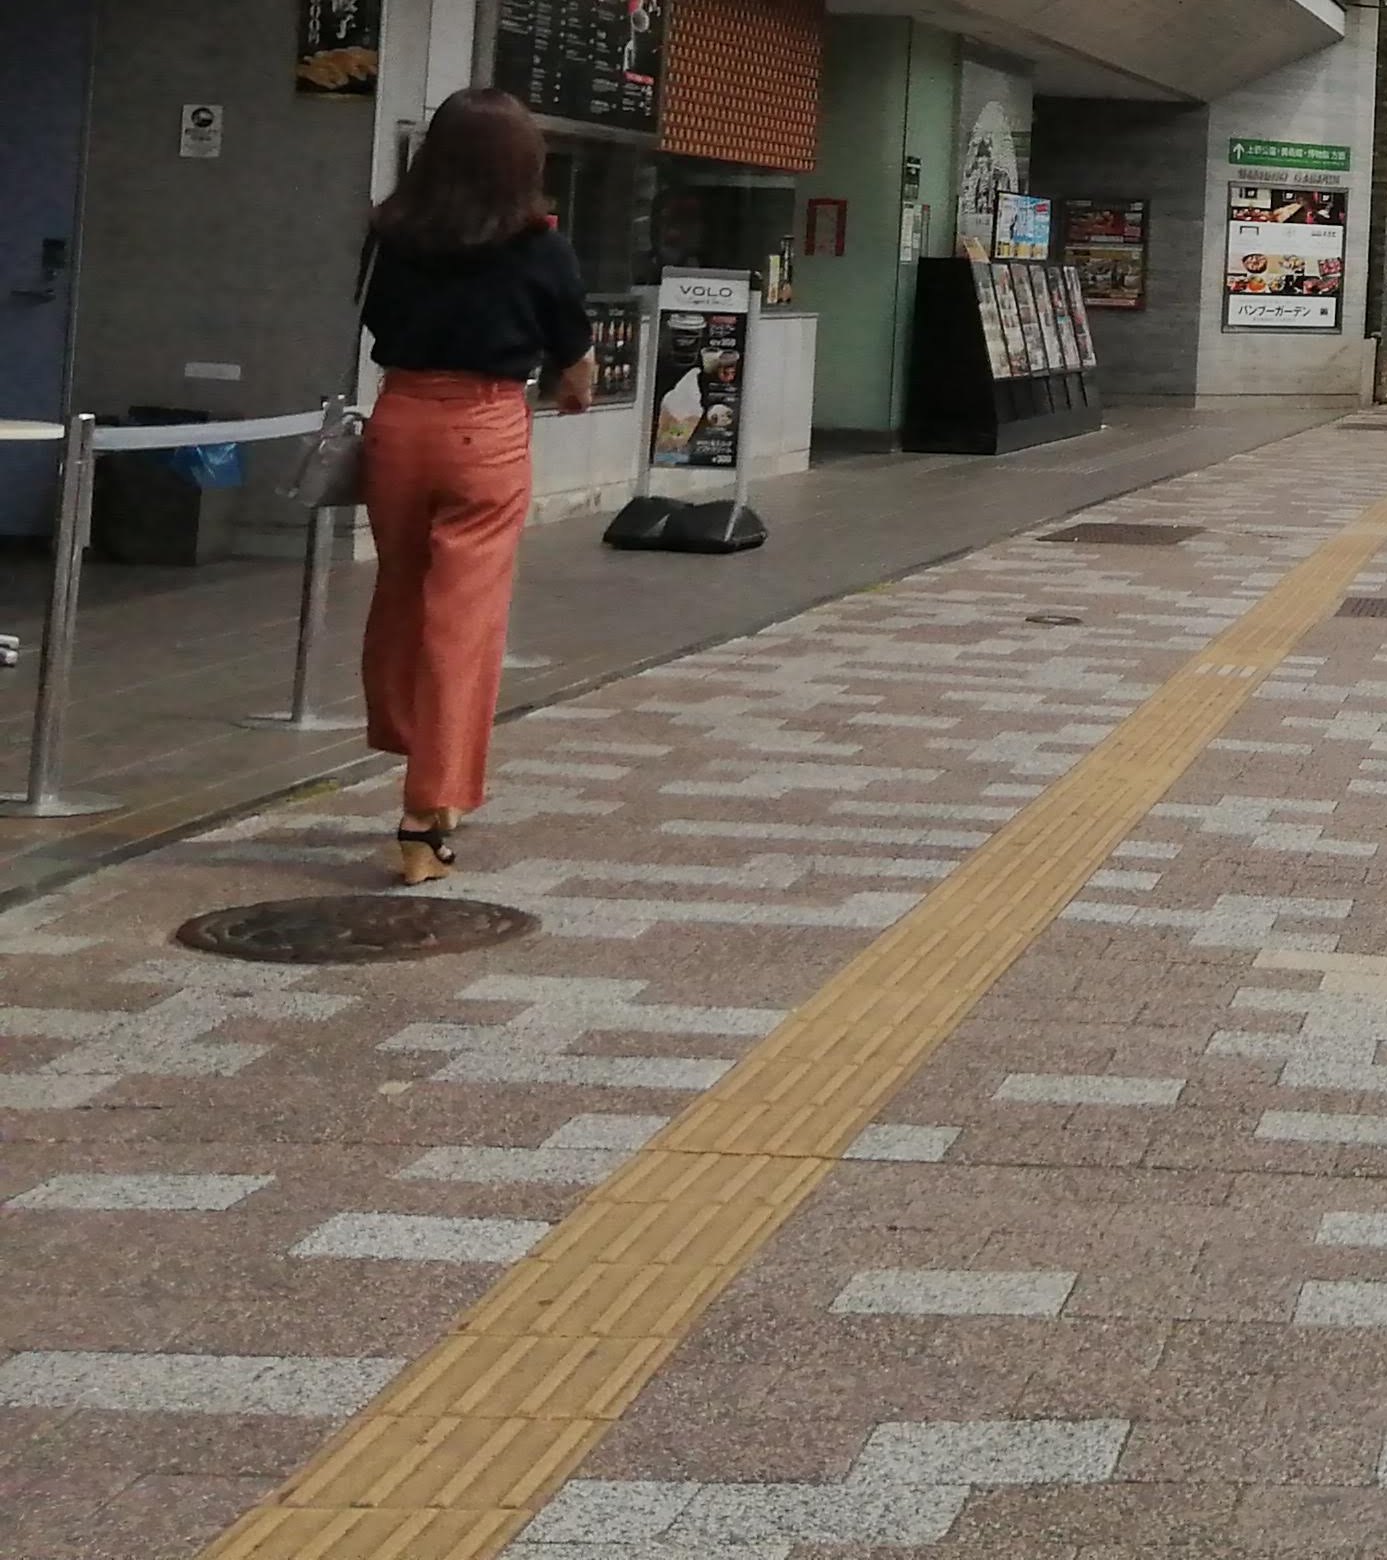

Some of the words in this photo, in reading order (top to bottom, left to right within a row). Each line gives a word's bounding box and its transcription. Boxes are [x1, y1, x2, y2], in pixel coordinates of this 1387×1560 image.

[679, 284, 734, 298] VOLO
[1238, 304, 1312, 317] バンブーガーデン
